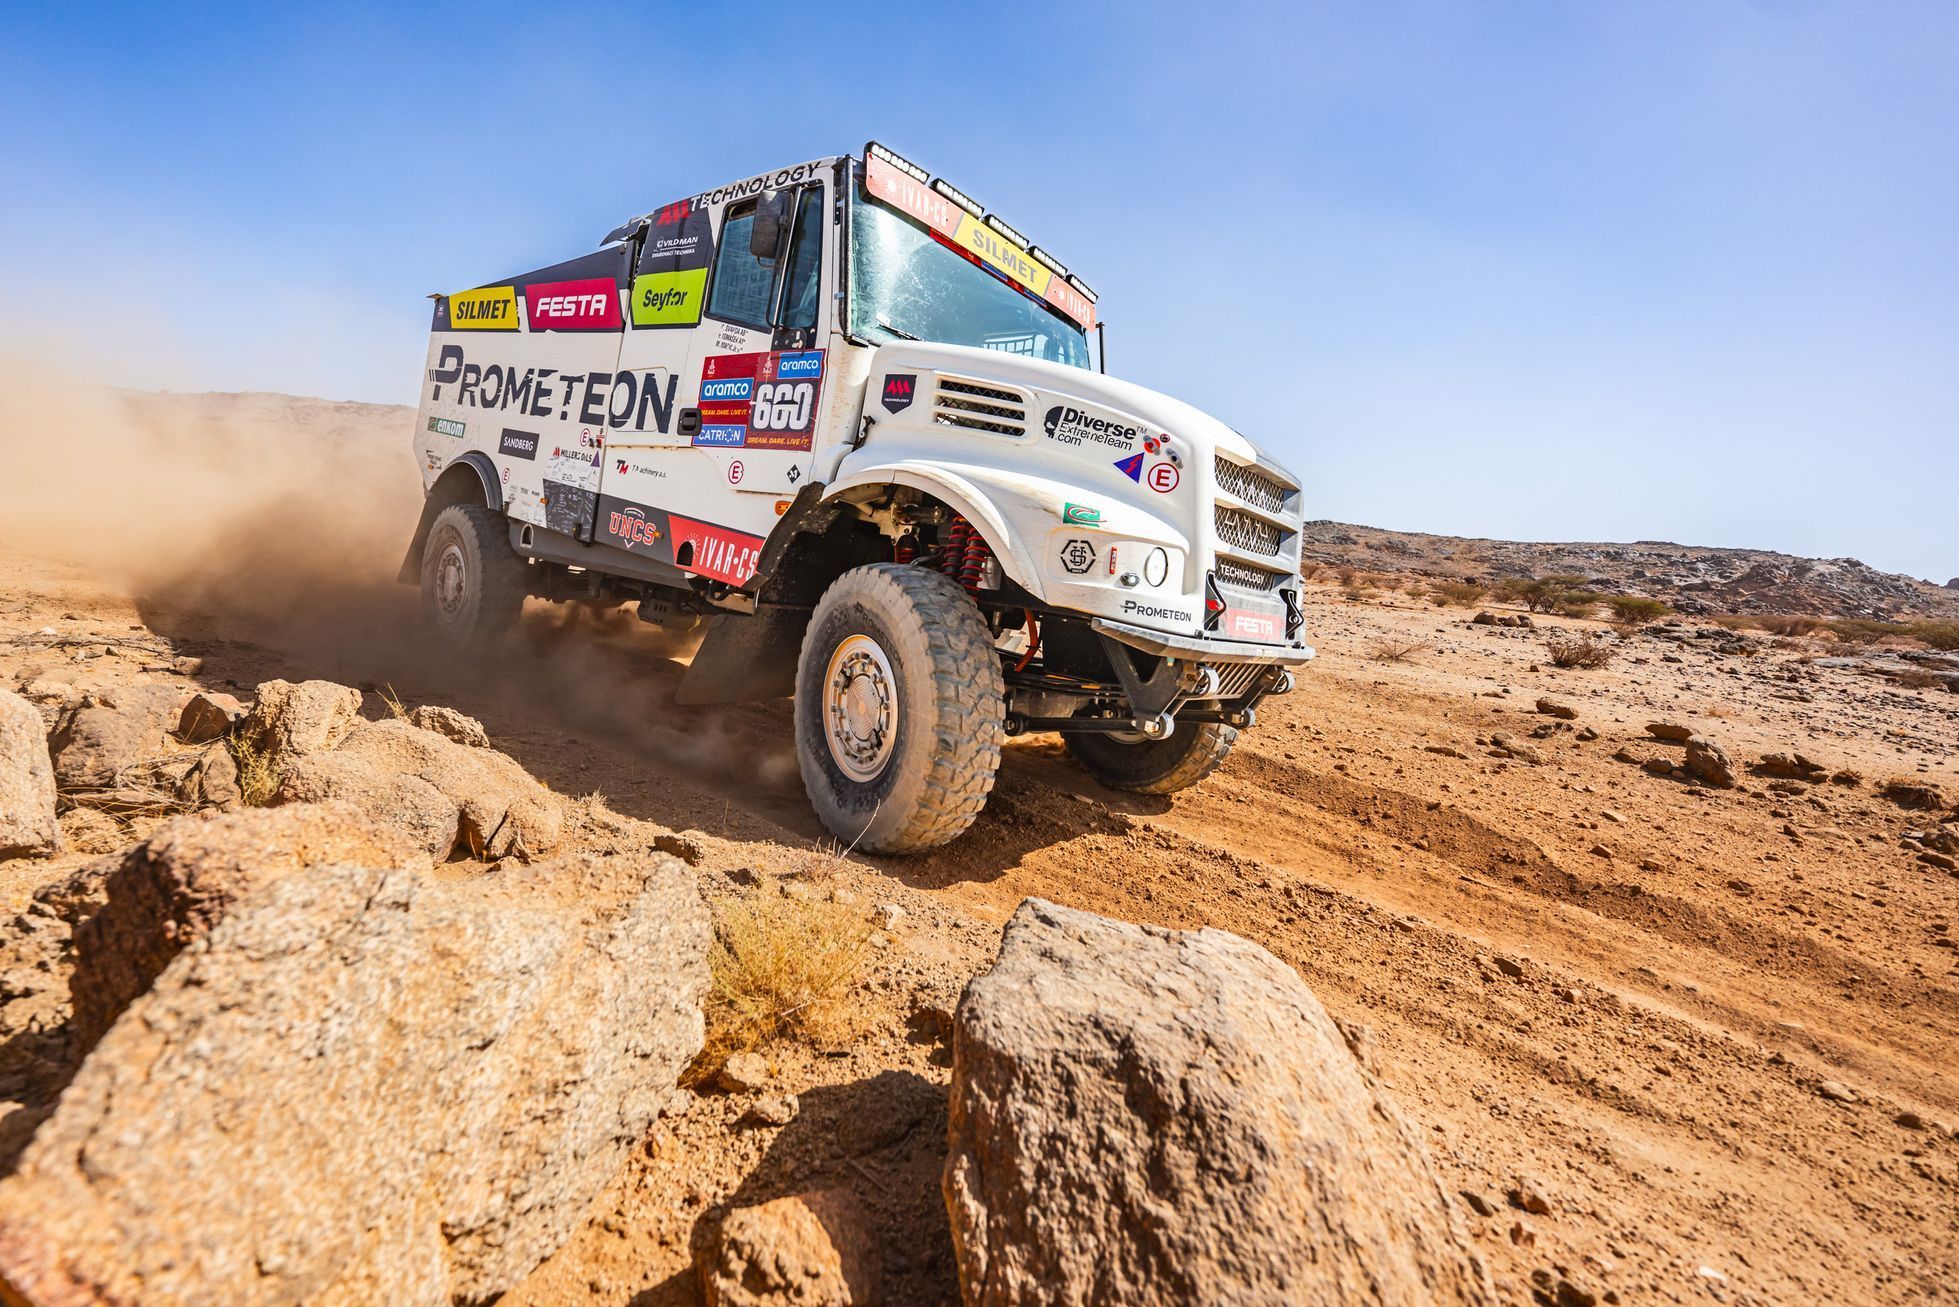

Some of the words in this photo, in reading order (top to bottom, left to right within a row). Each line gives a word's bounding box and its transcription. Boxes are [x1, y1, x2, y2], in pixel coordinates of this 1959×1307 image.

[690, 161, 822, 212] TECHNOLOGY
[973, 229, 1038, 283] SILMET
[456, 299, 511, 320] SILMET
[536, 294, 607, 318] FESTA
[781, 359, 819, 371] aramco
[429, 345, 679, 434] PROMETEON
[704, 382, 750, 397] aramco
[753, 383, 814, 430] 660
[437, 419, 465, 437] enkom
[1063, 408, 1136, 440] Diverse
[503, 436, 534, 452] SANDBERG
[698, 428, 741, 442] CATRION
[1055, 433, 1082, 447] .com
[1059, 422, 1133, 451] ExtremeTeam
[1155, 468, 1172, 487] E
[609, 511, 656, 545] UNCS
[1220, 564, 1265, 584] TECHNOLOGY
[1120, 600, 1192, 622] PROMETEON
[1235, 616, 1274, 634] FESTA
